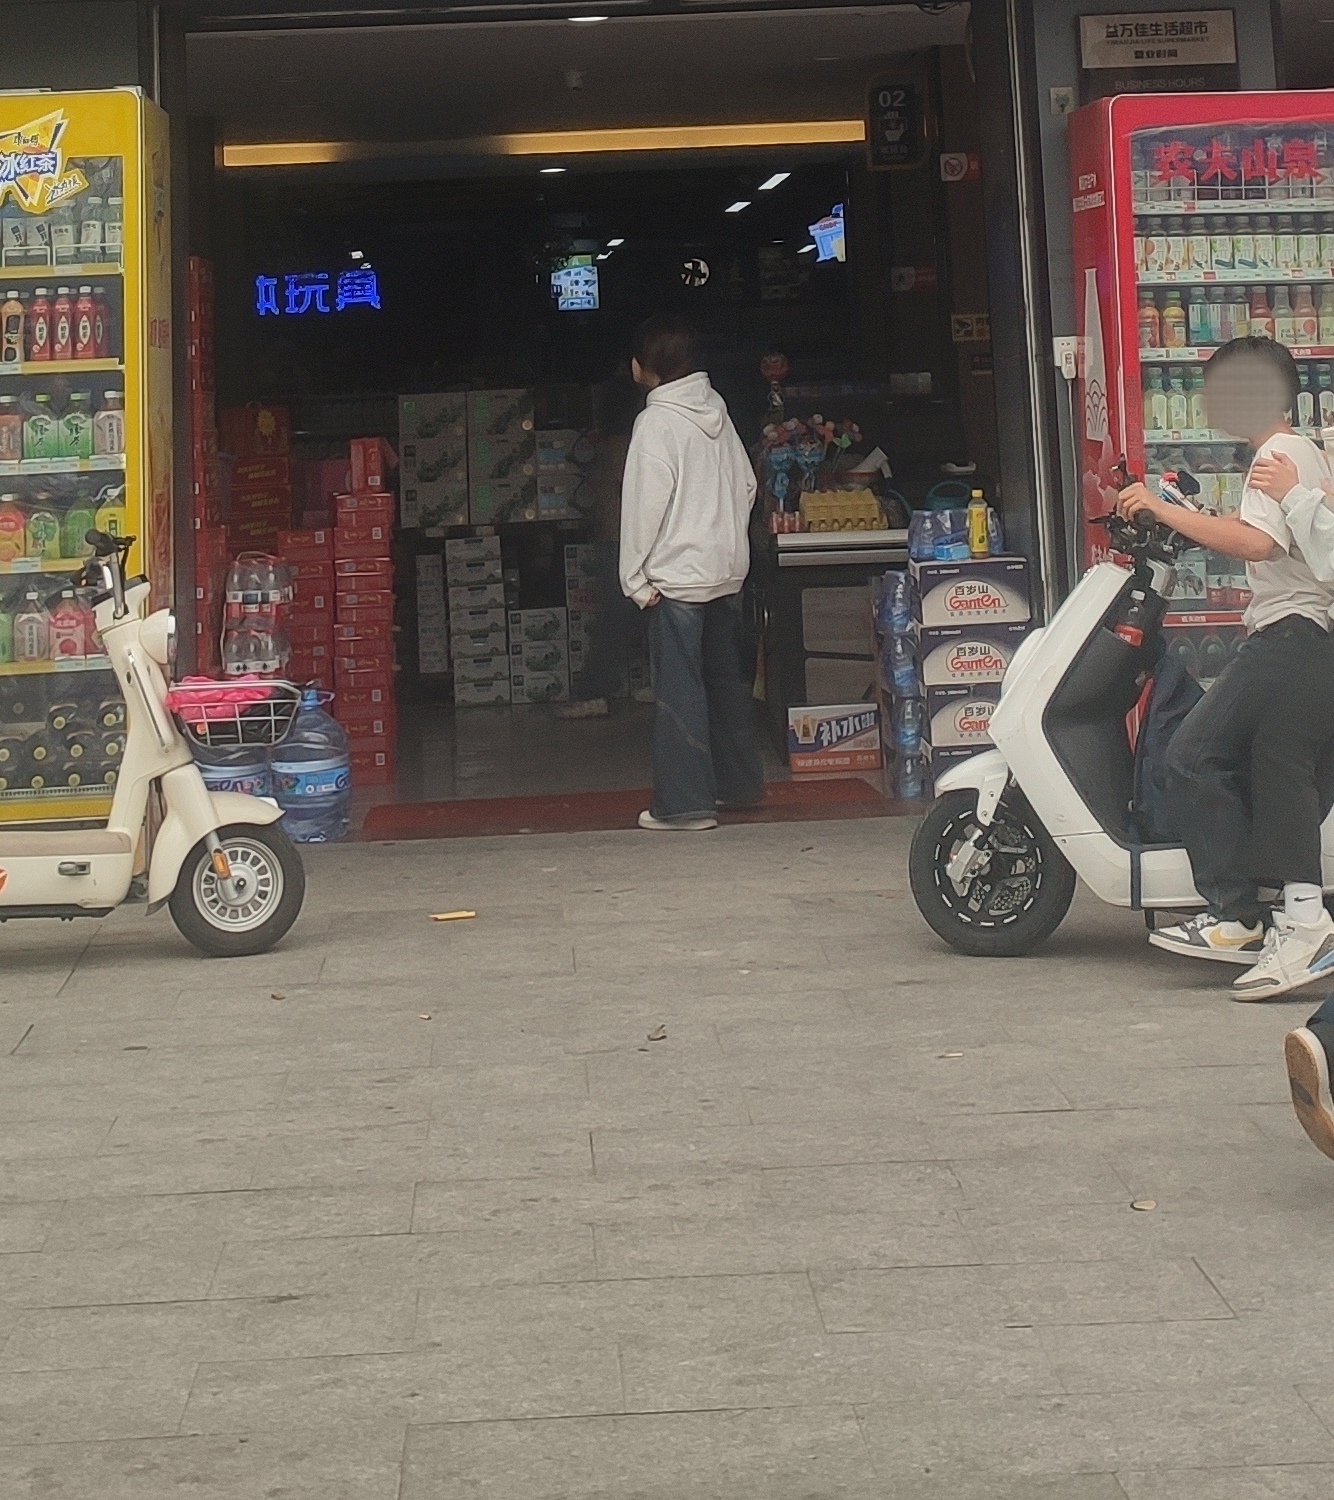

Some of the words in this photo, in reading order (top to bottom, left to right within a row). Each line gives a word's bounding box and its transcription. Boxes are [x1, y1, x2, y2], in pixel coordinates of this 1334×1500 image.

[1105, 20, 1209, 39] 益万佳生活超市
[878, 90, 906, 108] 02
[954, 584, 989, 596] 百岁山
[956, 645, 991, 657] 百岁山
